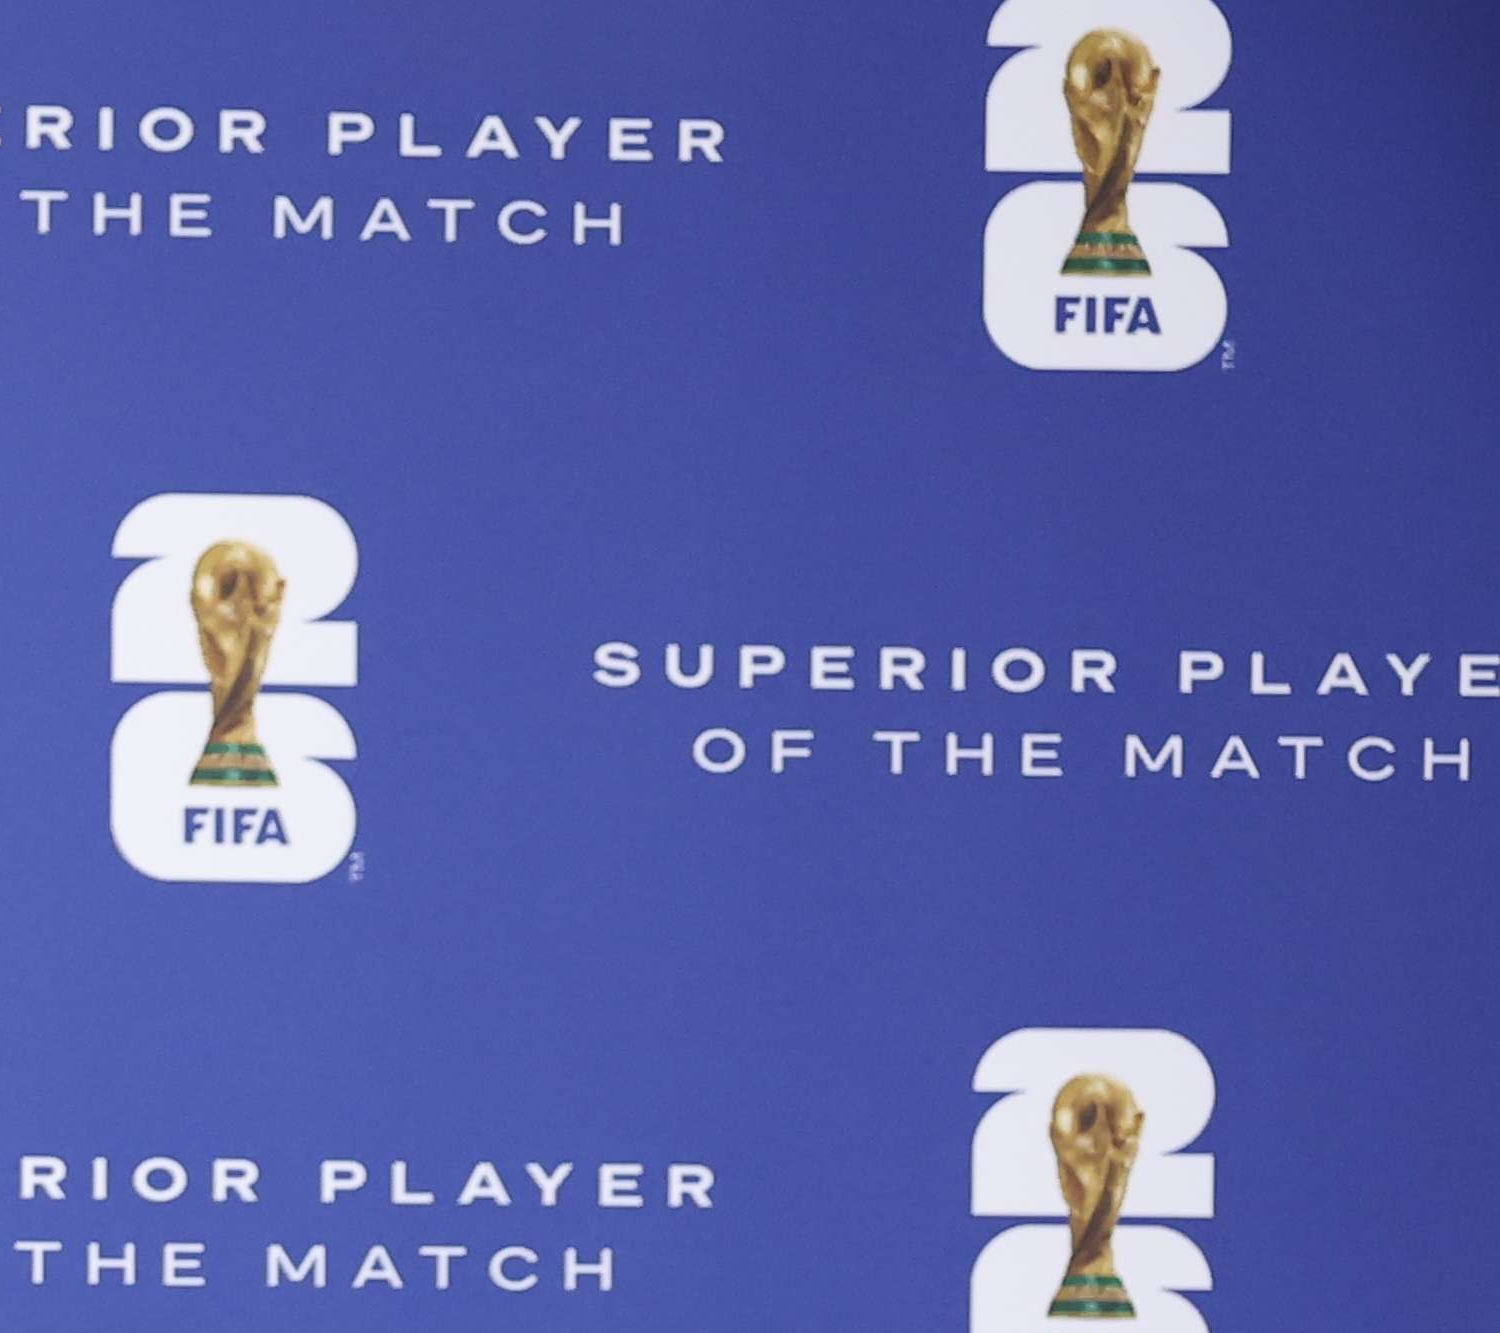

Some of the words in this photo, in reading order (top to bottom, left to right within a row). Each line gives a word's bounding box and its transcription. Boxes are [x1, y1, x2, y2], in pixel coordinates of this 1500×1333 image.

[328, 111, 725, 163] PLAYER
[19, 189, 212, 238] THE
[273, 195, 622, 246] MATCH
[1054, 295, 1162, 335] FIFA
[593, 641, 1117, 693] SUPERIOR
[1179, 650, 1500, 697] PLAYE
[692, 728, 814, 773] OF
[872, 731, 1063, 777] THE
[1124, 734, 1470, 781] MATCH
[183, 806, 289, 846] FIFA
[320, 1159, 714, 1208] PLAYER
[13, 1240, 206, 1287] THE
[266, 1243, 613, 1292] MATCH
